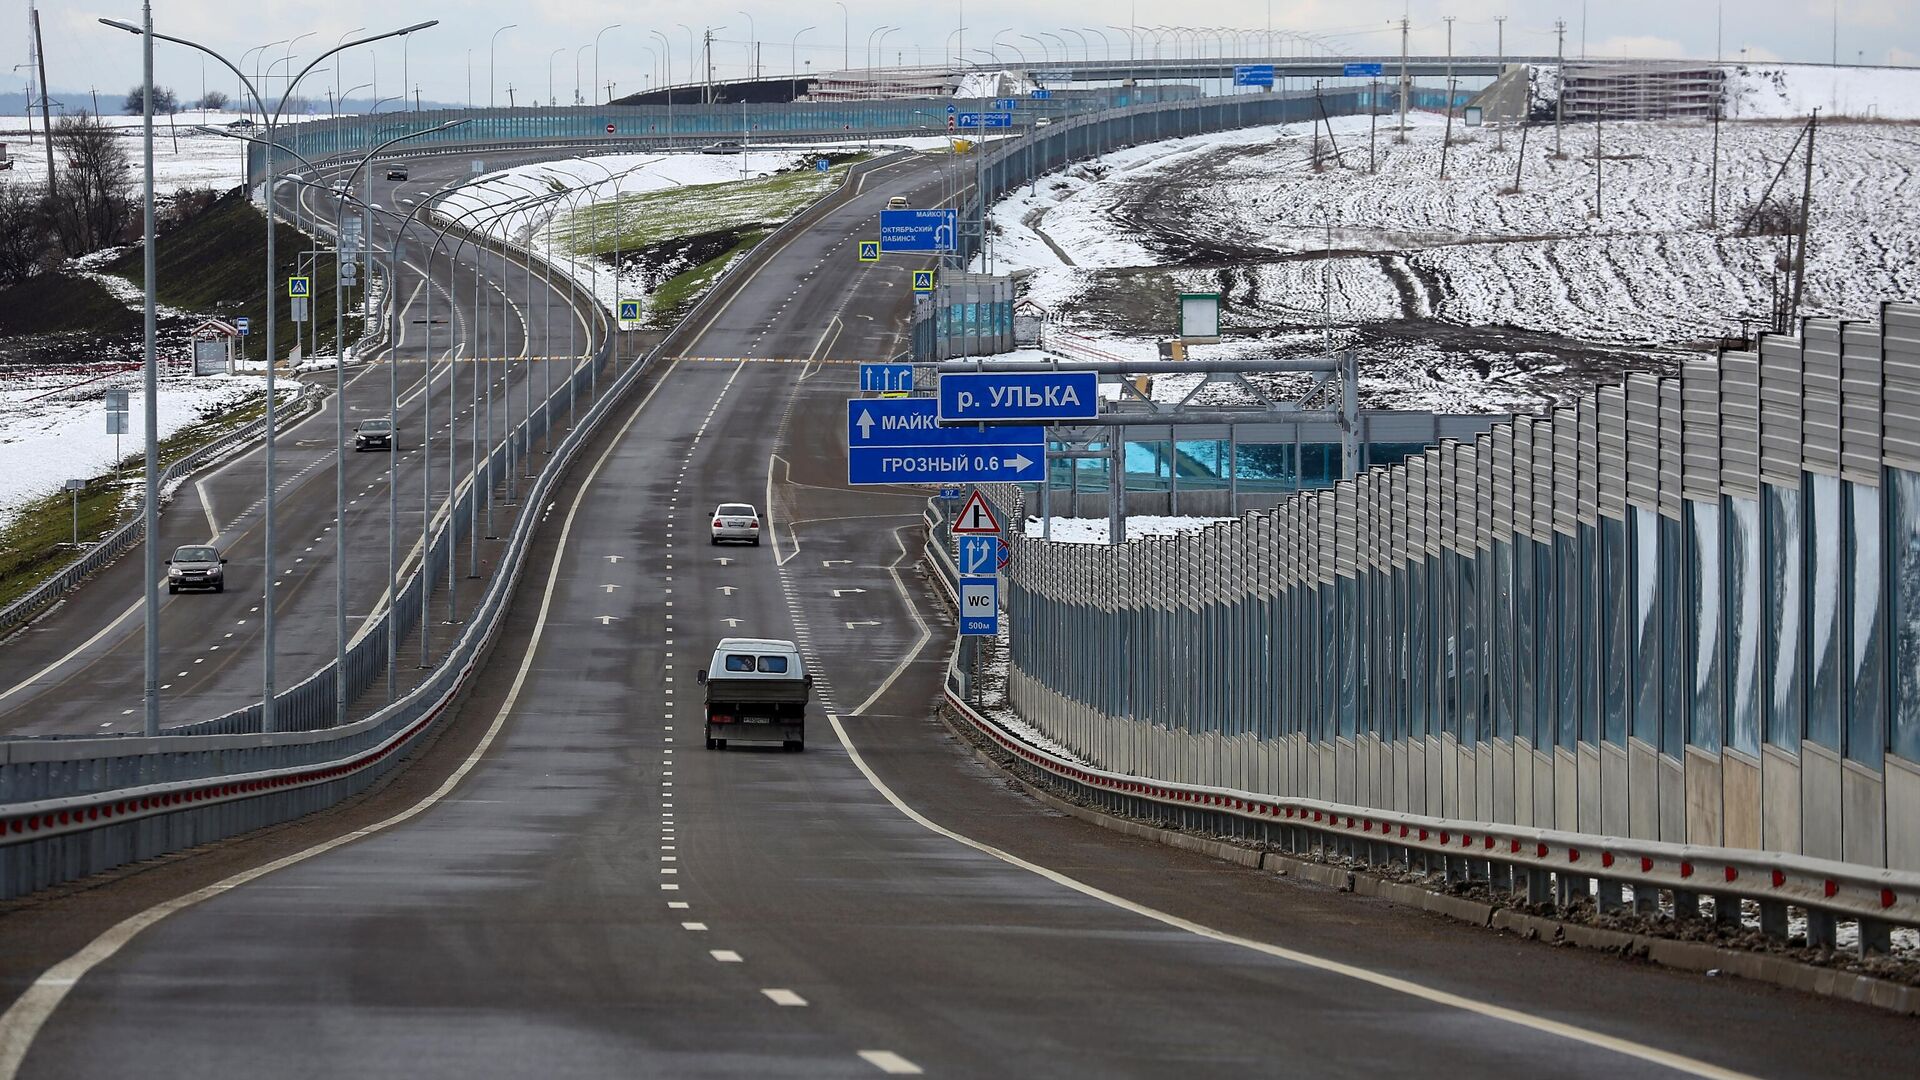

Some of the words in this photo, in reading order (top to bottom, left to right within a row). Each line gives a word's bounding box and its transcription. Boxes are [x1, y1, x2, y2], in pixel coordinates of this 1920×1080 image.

[882, 225, 933, 233] ОКТЯБРЬСКИЙ
[958, 391, 980, 412] р.
[988, 385, 1080, 407] УЛЬКА
[882, 411, 960, 430] МАЙК
[882, 454, 969, 473] ГРОЗНЫЙ
[974, 456, 999, 472] 0.6
[968, 596, 990, 607] WC
[968, 622, 990, 630] 500м
